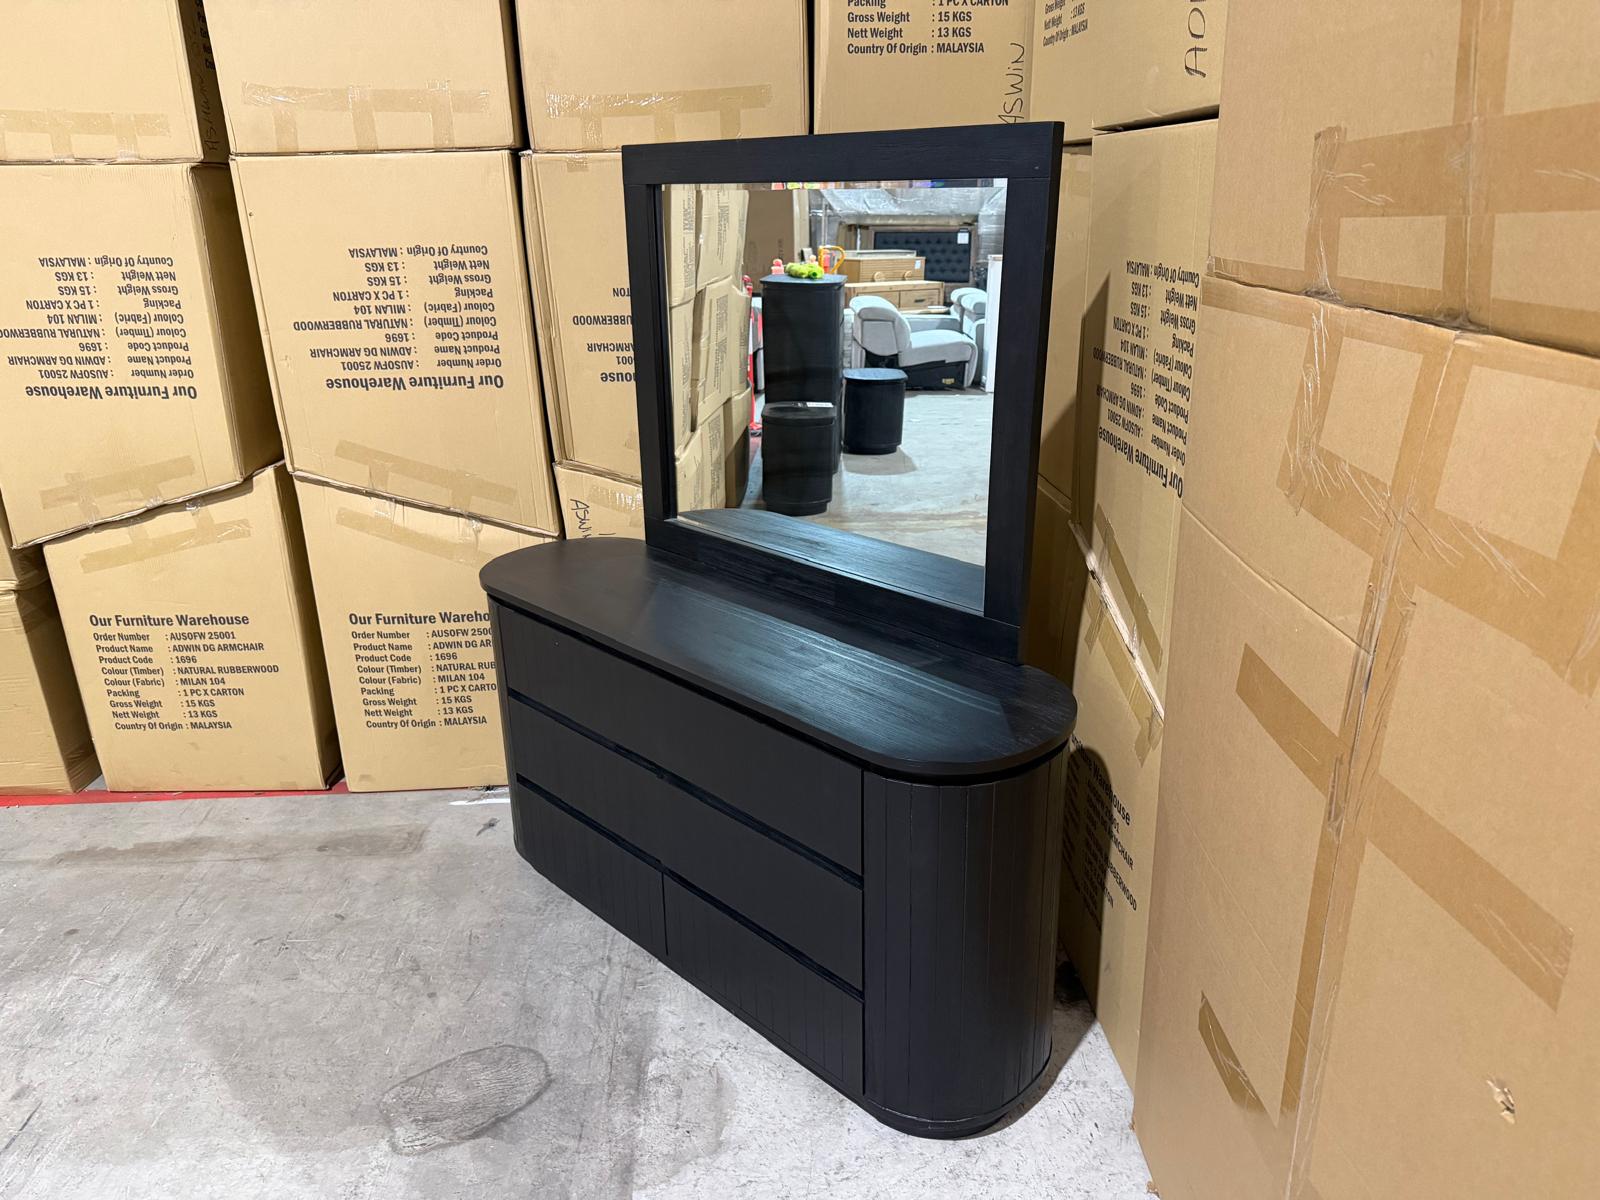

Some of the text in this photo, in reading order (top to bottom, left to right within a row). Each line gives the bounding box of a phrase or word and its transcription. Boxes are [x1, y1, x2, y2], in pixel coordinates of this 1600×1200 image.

[848, 12, 972, 24] Gross Weight 15 KGS
[848, 27, 971, 40] Nett Weight 13 KGS
[848, 43, 984, 55] Country Of Origin MALAYSIA
[349, 244, 488, 257] Country Of Origin MALAYSIA
[39, 256, 173, 266] Country Of Origin MALAYSIA
[613, 288, 631, 297] TON
[354, 303, 495, 314] Colour (Fabric) MILAN 104
[294, 317, 496, 330] Colour (Timber) NATURAL RUBBERWOOD
[573, 315, 633, 325] UBBERWOOD
[0, 328, 186, 338] Colour (Timber) NATURAL RUBBERWO
[385, 331, 498, 342] Product Code 1696
[310, 345, 500, 357] Product Name ADWIN DG ARMCHAIR
[8, 356, 191, 365] Product Name ADWIN DG ARMCHAIR
[342, 359, 501, 370] Order Number AUSOFW 25001
[616, 356, 634, 365] 001
[39, 370, 68, 378] 25001
[131, 370, 167, 378] Number
[169, 370, 194, 378] Order
[326, 375, 504, 390] Our Furniture Warehouse
[26, 386, 197, 399] Our Furniture Warehouse
[90, 614, 249, 627] Our Furniture Warehouse
[349, 611, 490, 625] Our Furniture Wareho
[93, 631, 235, 641] Order Number AUSOFW 25001
[352, 631, 375, 639] Order
[432, 629, 468, 638] AUSOFW
[471, 628, 492, 636] 2500
[96, 643, 264, 653] Product Name ADWIN DG ARMCHAIR
[354, 643, 386, 651] Product
[433, 642, 462, 650] ADWIN
[99, 656, 131, 664] Product
[132, 656, 153, 664] Code
[390, 654, 411, 662] Code
[435, 653, 457, 661] 1696
[101, 665, 279, 676] Colour (Timber) NATURAL RUBBERWOOD
[387, 665, 421, 674] (Timber)
[437, 663, 476, 672] NATURAL
[104, 677, 225, 687] Colour (Fabric) MILAN 104
[388, 677, 421, 685] (Fabric)
[438, 674, 466, 682] MILAN
[469, 673, 485, 681] 104
[107, 689, 140, 698] Packing
[210, 688, 244, 696] CARTON
[110, 700, 132, 708] Gross
[134, 700, 162, 709] Weight
[388, 698, 417, 707] Weight
[132, 710, 159, 719] Weight
[201, 710, 217, 718] KGS
[365, 709, 382, 717] Nett
[384, 709, 412, 717] Weight
[456, 706, 473, 714] KGS
[115, 722, 232, 731] Country Of Origin MALAYSIA
[366, 717, 487, 729] Country Of Origin MALAYSIA
